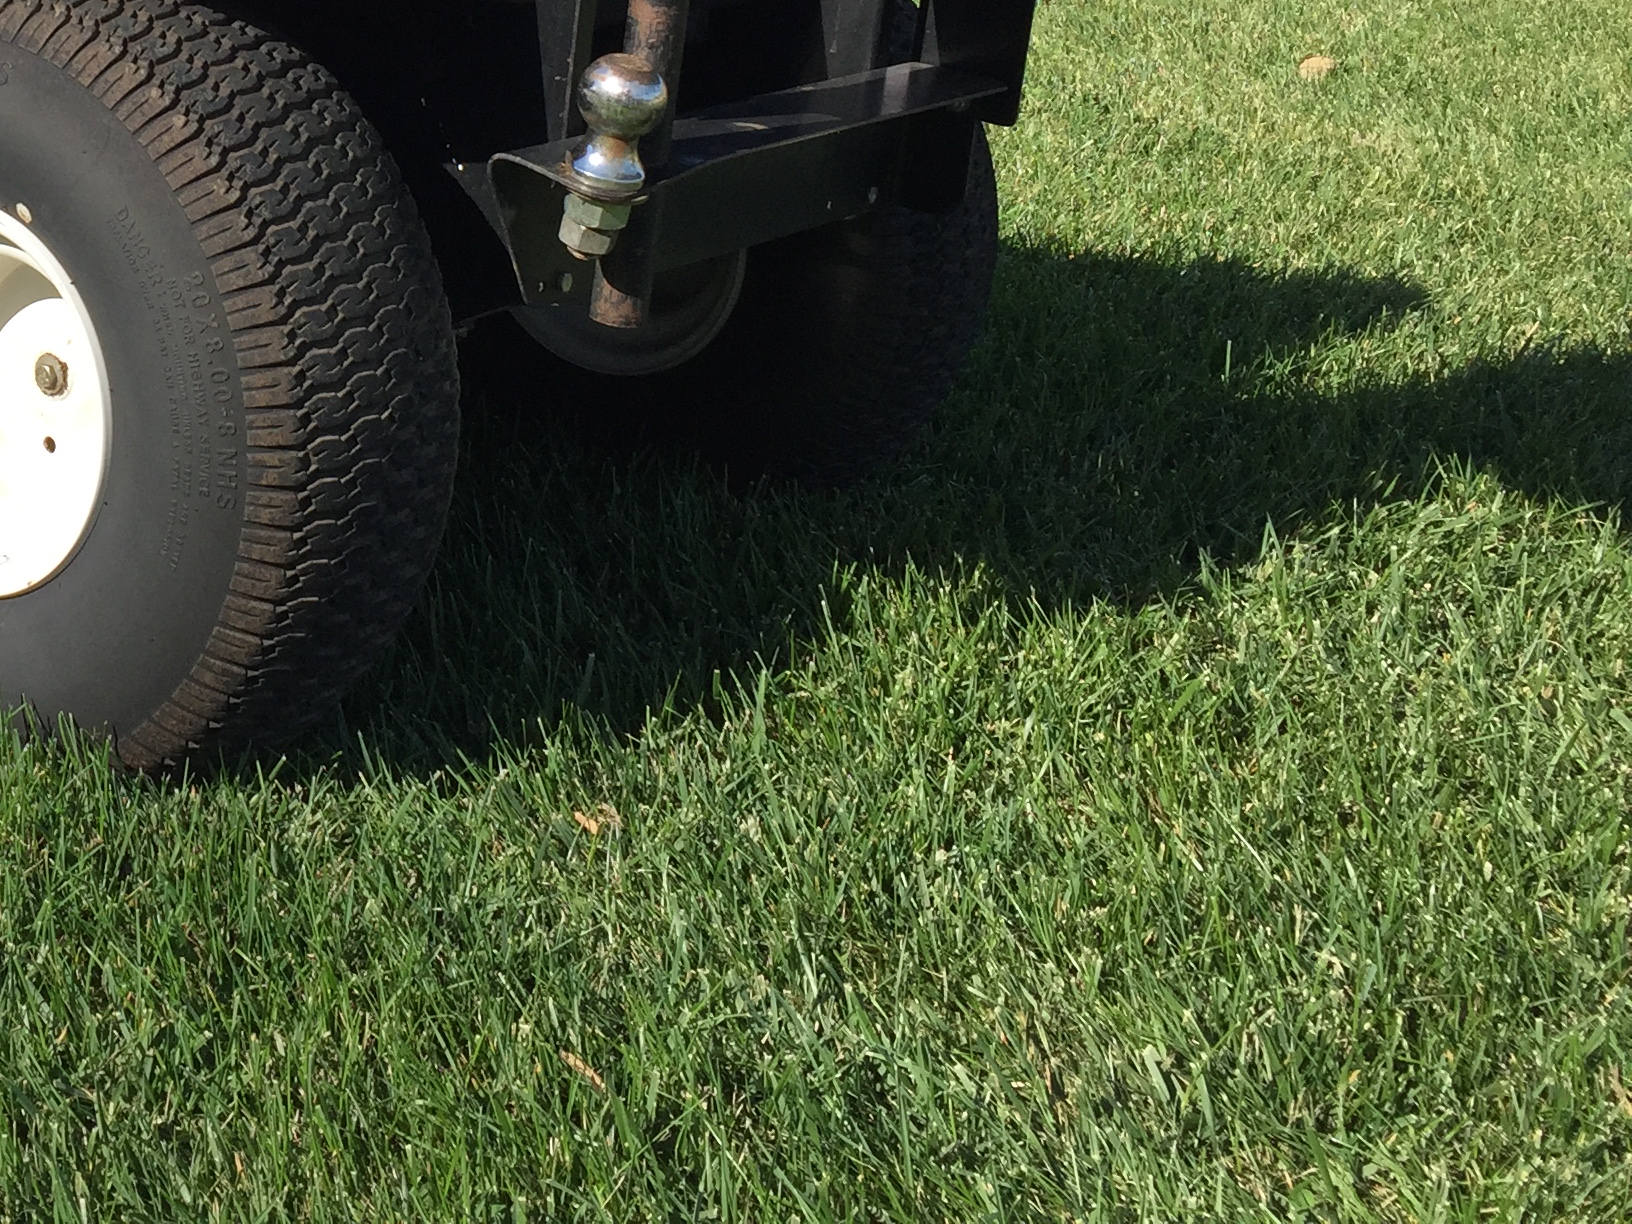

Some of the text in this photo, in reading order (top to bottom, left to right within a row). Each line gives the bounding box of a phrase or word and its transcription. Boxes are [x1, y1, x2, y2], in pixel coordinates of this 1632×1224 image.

[167, 278, 187, 309] NOT
[179, 314, 196, 346] FOR
[186, 352, 210, 426] HIGHWAY
[199, 434, 212, 498] SERVICE
[217, 448, 238, 510] NHS
